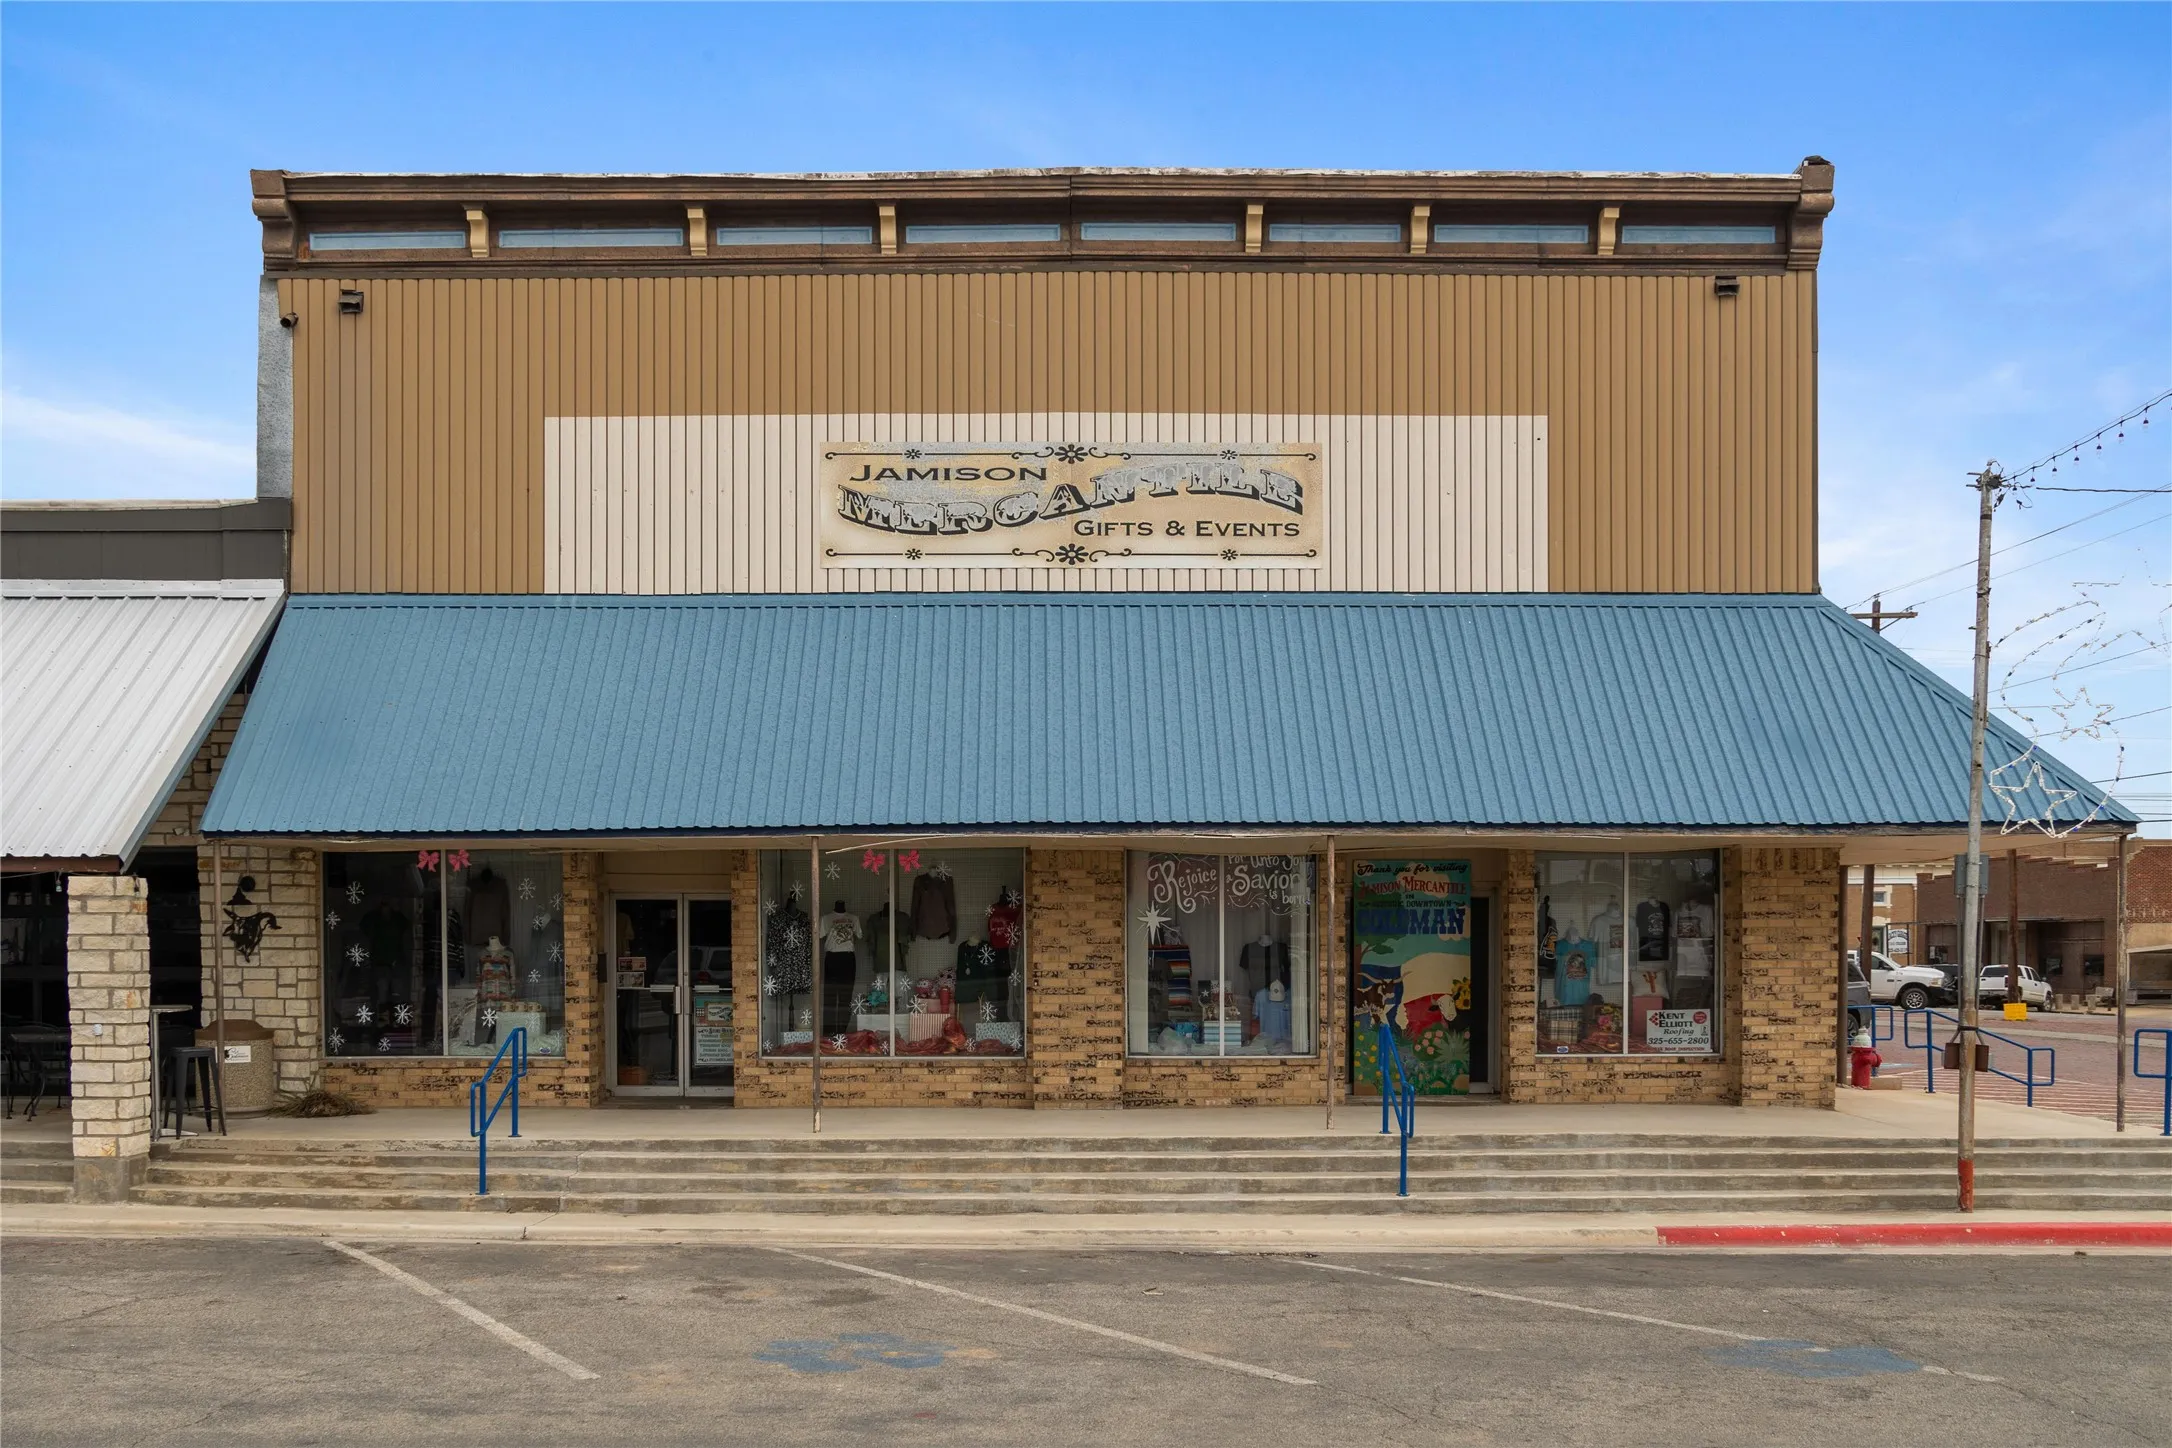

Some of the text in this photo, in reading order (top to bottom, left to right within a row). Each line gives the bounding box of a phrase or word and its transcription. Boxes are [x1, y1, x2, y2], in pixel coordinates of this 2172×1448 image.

[849, 464, 1048, 482] JAMISON
[837, 462, 1304, 536] MERCANTILE
[1073, 519, 1300, 537] GIFTS & EVENTS
[1357, 863, 1468, 876] Thank you for visiting
[1231, 864, 1301, 897] Savior
[1146, 860, 1218, 914] Rejoice
[1268, 889, 1278, 900] is
[1406, 900, 1452, 908] DOWNTOWN
[1659, 1011, 1685, 1019] KENT
[1659, 1020, 1693, 1028] ELLIOTT
[1664, 1028, 1694, 1036] Roofing
[1648, 1037, 1709, 1045] 325-655-2800
